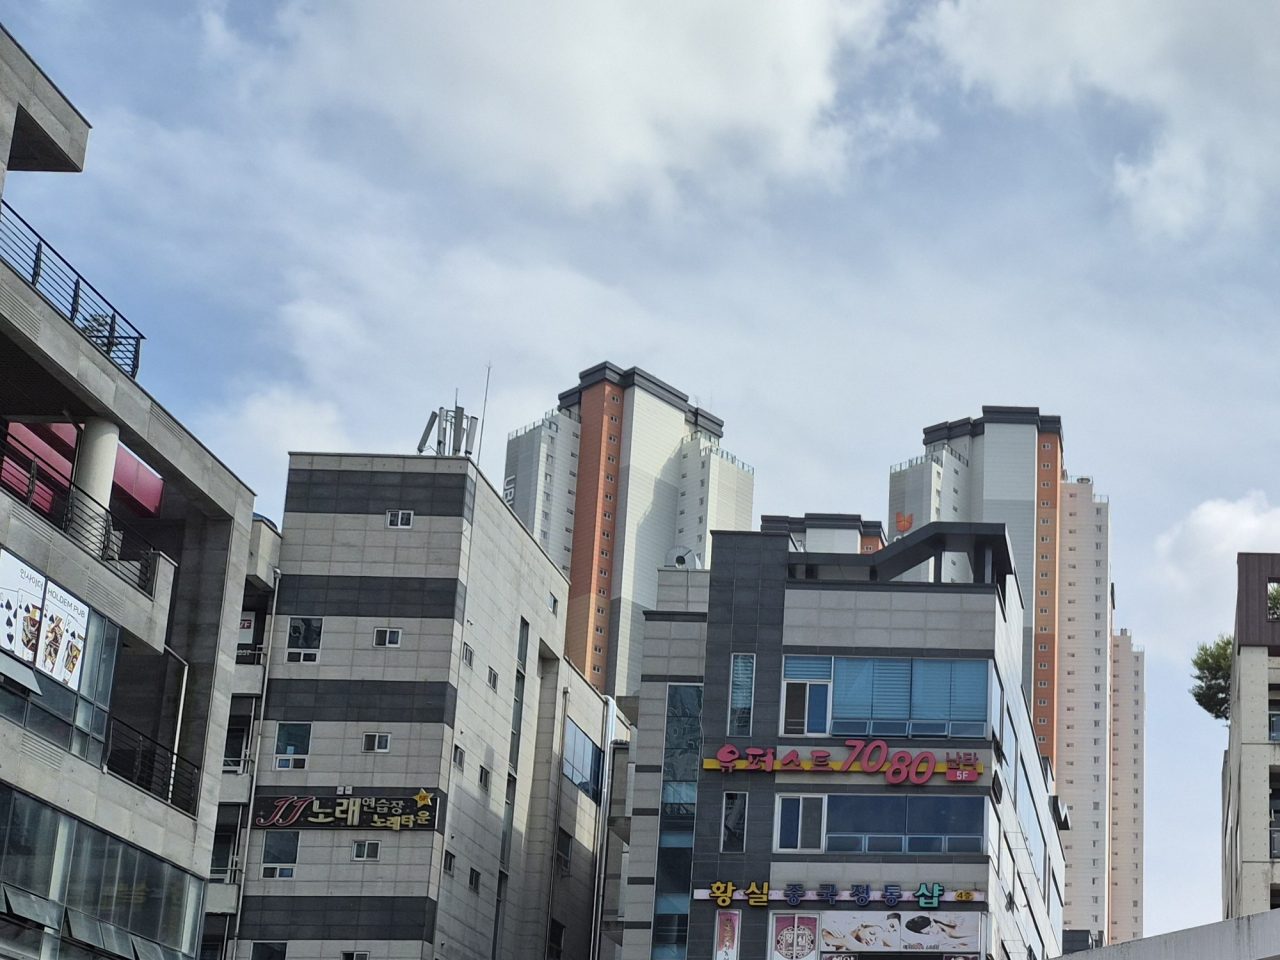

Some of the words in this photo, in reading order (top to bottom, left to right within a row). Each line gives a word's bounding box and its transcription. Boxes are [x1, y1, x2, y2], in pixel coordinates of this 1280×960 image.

[48, 588, 73, 612] HOLDEM
[73, 603, 86, 618] PUB
[838, 739, 937, 785] 7080
[956, 770, 970, 781] 5F
[710, 881, 769, 908] 황실
[914, 882, 944, 908] 샵
